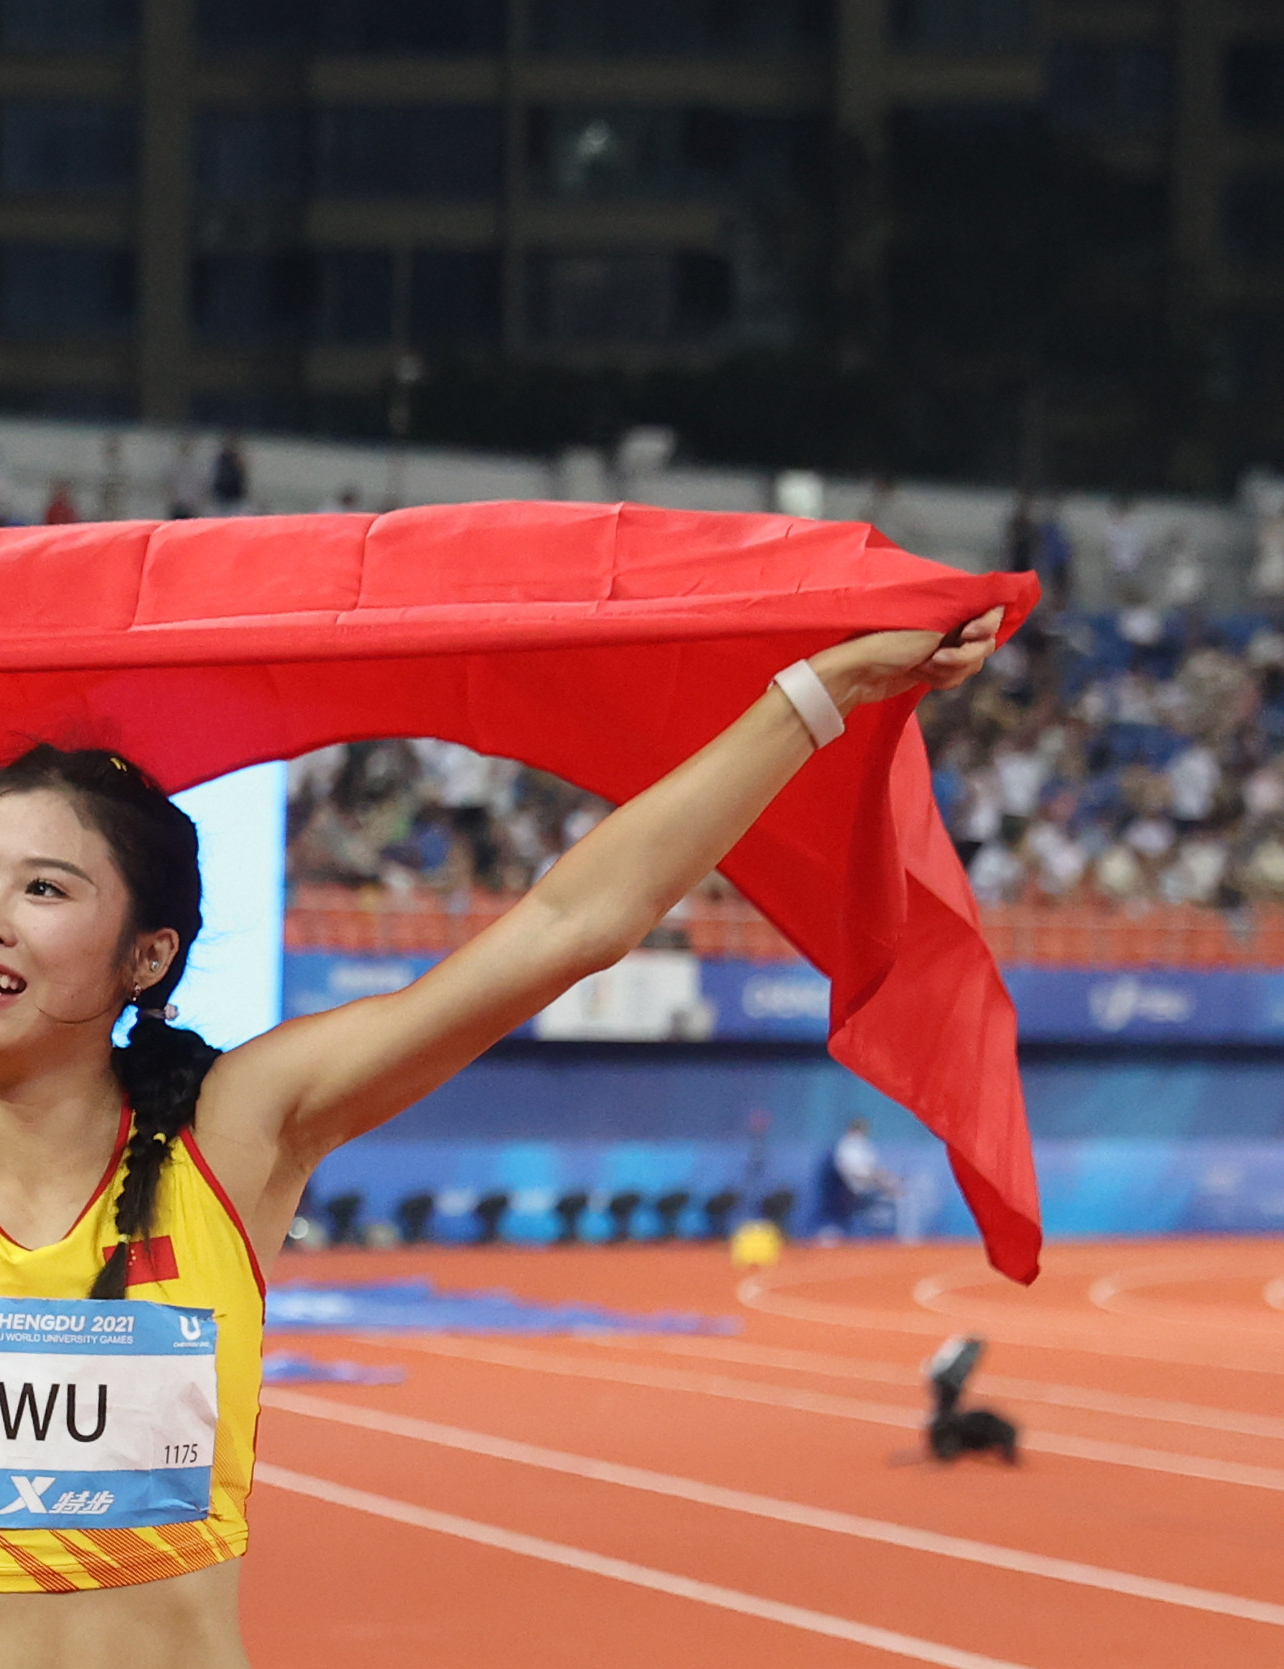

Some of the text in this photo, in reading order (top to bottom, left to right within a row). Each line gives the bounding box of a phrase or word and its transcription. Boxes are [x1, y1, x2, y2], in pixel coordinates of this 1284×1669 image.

[91, 1315, 134, 1333] 2021
[5, 1332, 40, 1343] WORLD
[43, 1333, 97, 1344] UNIVERSITY
[100, 1335, 134, 1345] GAMES
[164, 1443, 199, 1464] 1175
[48, 1490, 115, 1515] 特步
